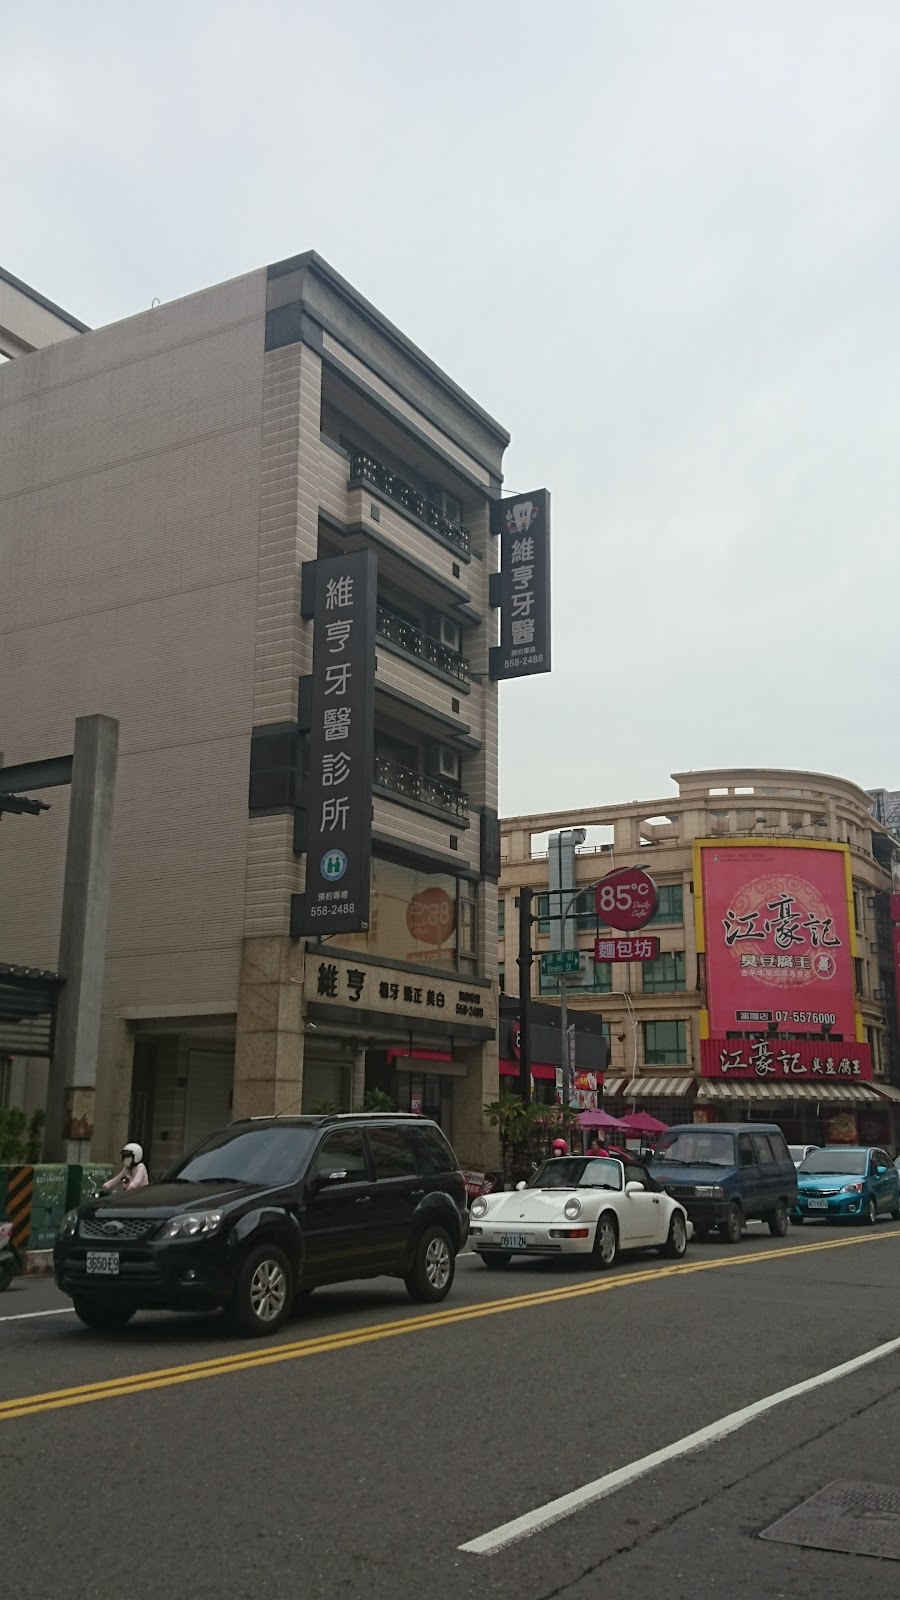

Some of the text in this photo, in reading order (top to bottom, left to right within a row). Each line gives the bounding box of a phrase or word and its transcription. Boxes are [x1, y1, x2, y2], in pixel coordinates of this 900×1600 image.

[511, 537, 535, 646] 維亨牙醫
[504, 654, 544, 668] 558-2488
[320, 575, 354, 832] 維亨牙醫診所
[317, 890, 349, 901] 預約專線
[310, 903, 355, 917] 558-2488
[723, 893, 842, 949] 江豪記
[598, 940, 652, 958] 麵包坊
[740, 954, 812, 970] 臭豆腐王
[317, 962, 366, 1001] 維亨
[775, 1010, 836, 1024] 07-5576000
[719, 1039, 861, 1076] 江豪記 臭豆腐王
